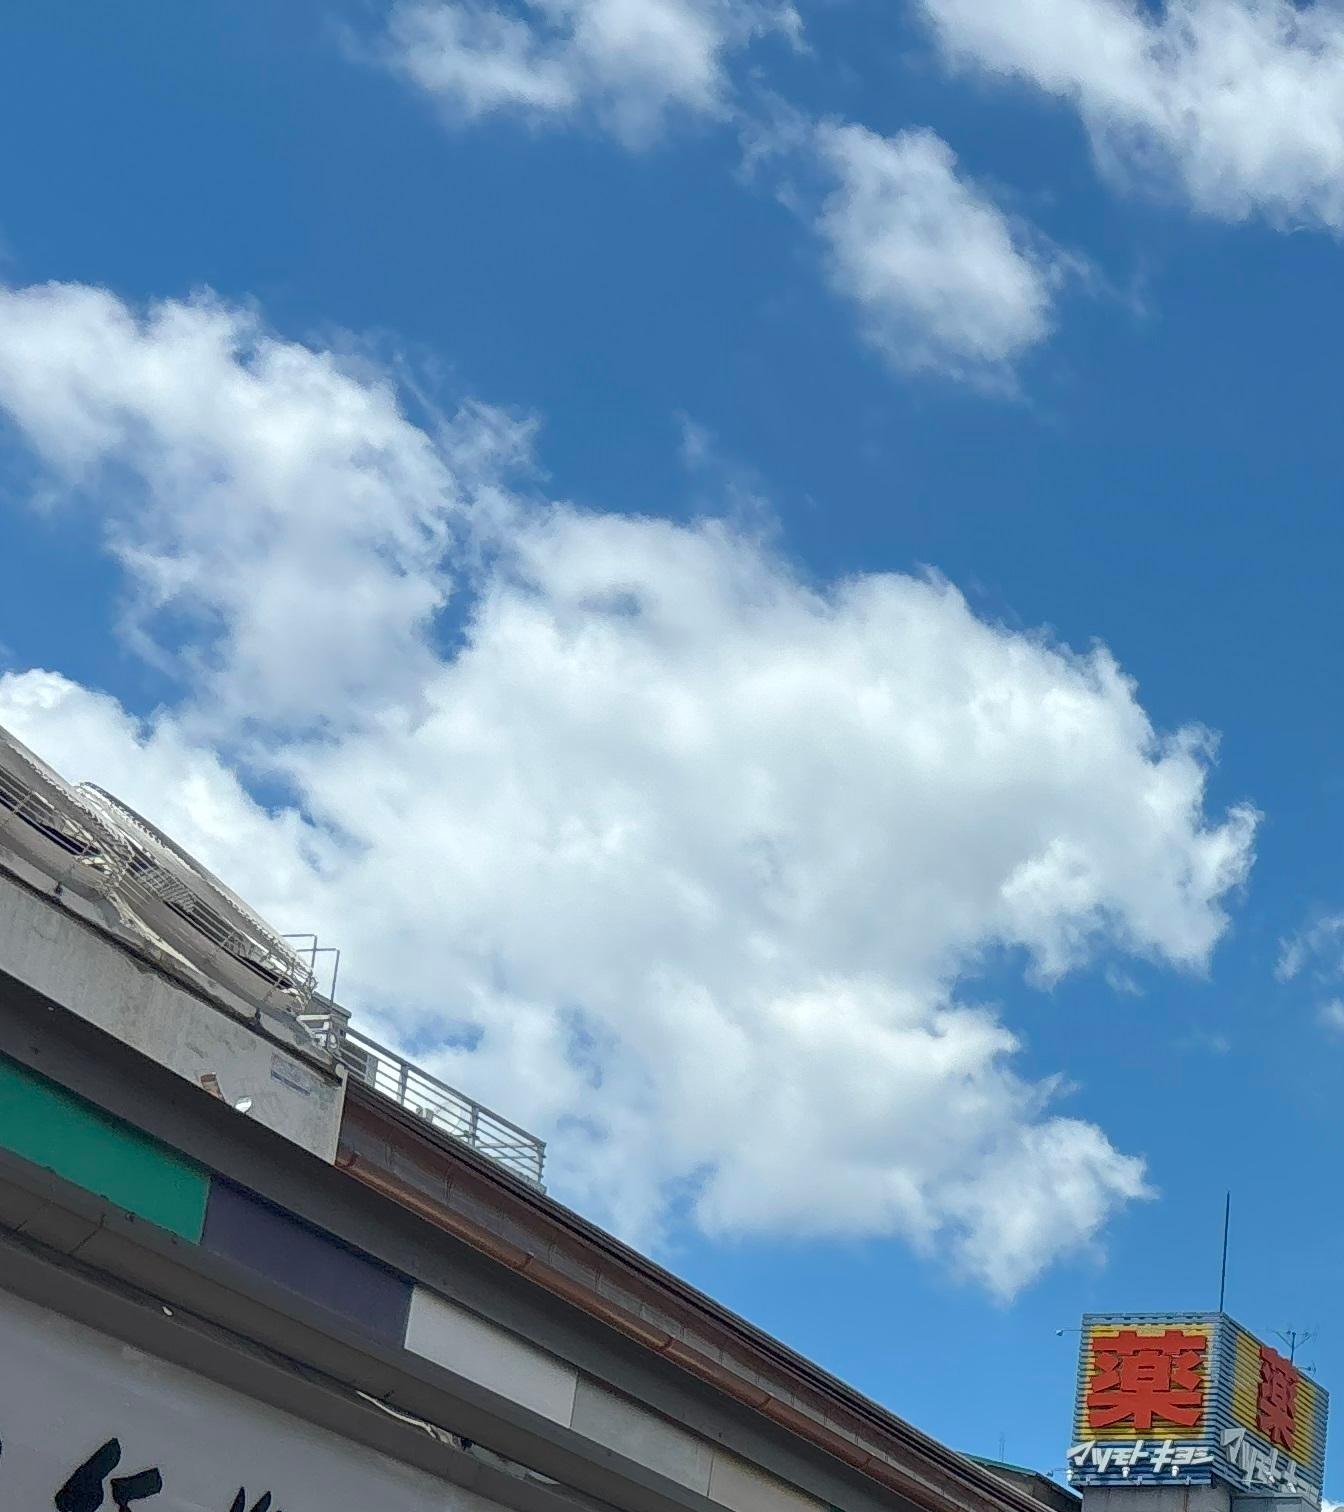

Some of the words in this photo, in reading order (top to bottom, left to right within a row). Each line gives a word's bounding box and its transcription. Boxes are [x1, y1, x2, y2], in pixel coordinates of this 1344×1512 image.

[1087, 1330, 1207, 1429] 薬
[1257, 1346, 1298, 1450] 薬
[1066, 1440, 1214, 1473] マツモトキヨシ
